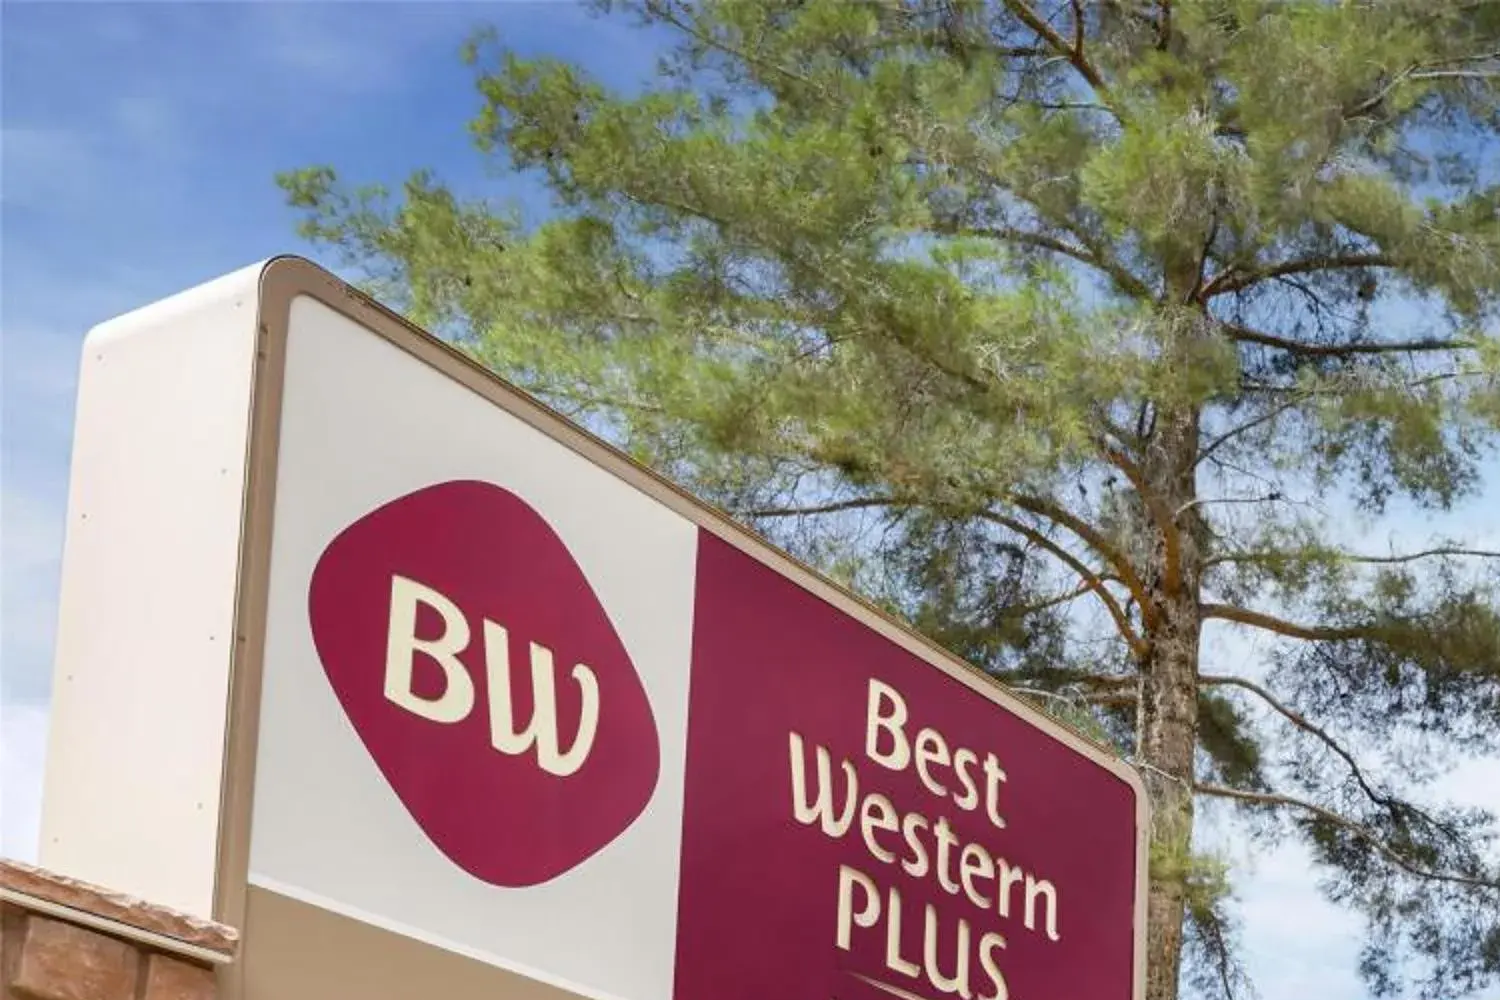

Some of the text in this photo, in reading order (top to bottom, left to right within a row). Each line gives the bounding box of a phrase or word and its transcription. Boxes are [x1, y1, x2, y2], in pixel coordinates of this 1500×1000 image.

[383, 573, 600, 777] BW
[866, 678, 1007, 829] Best
[789, 731, 1061, 942] Western
